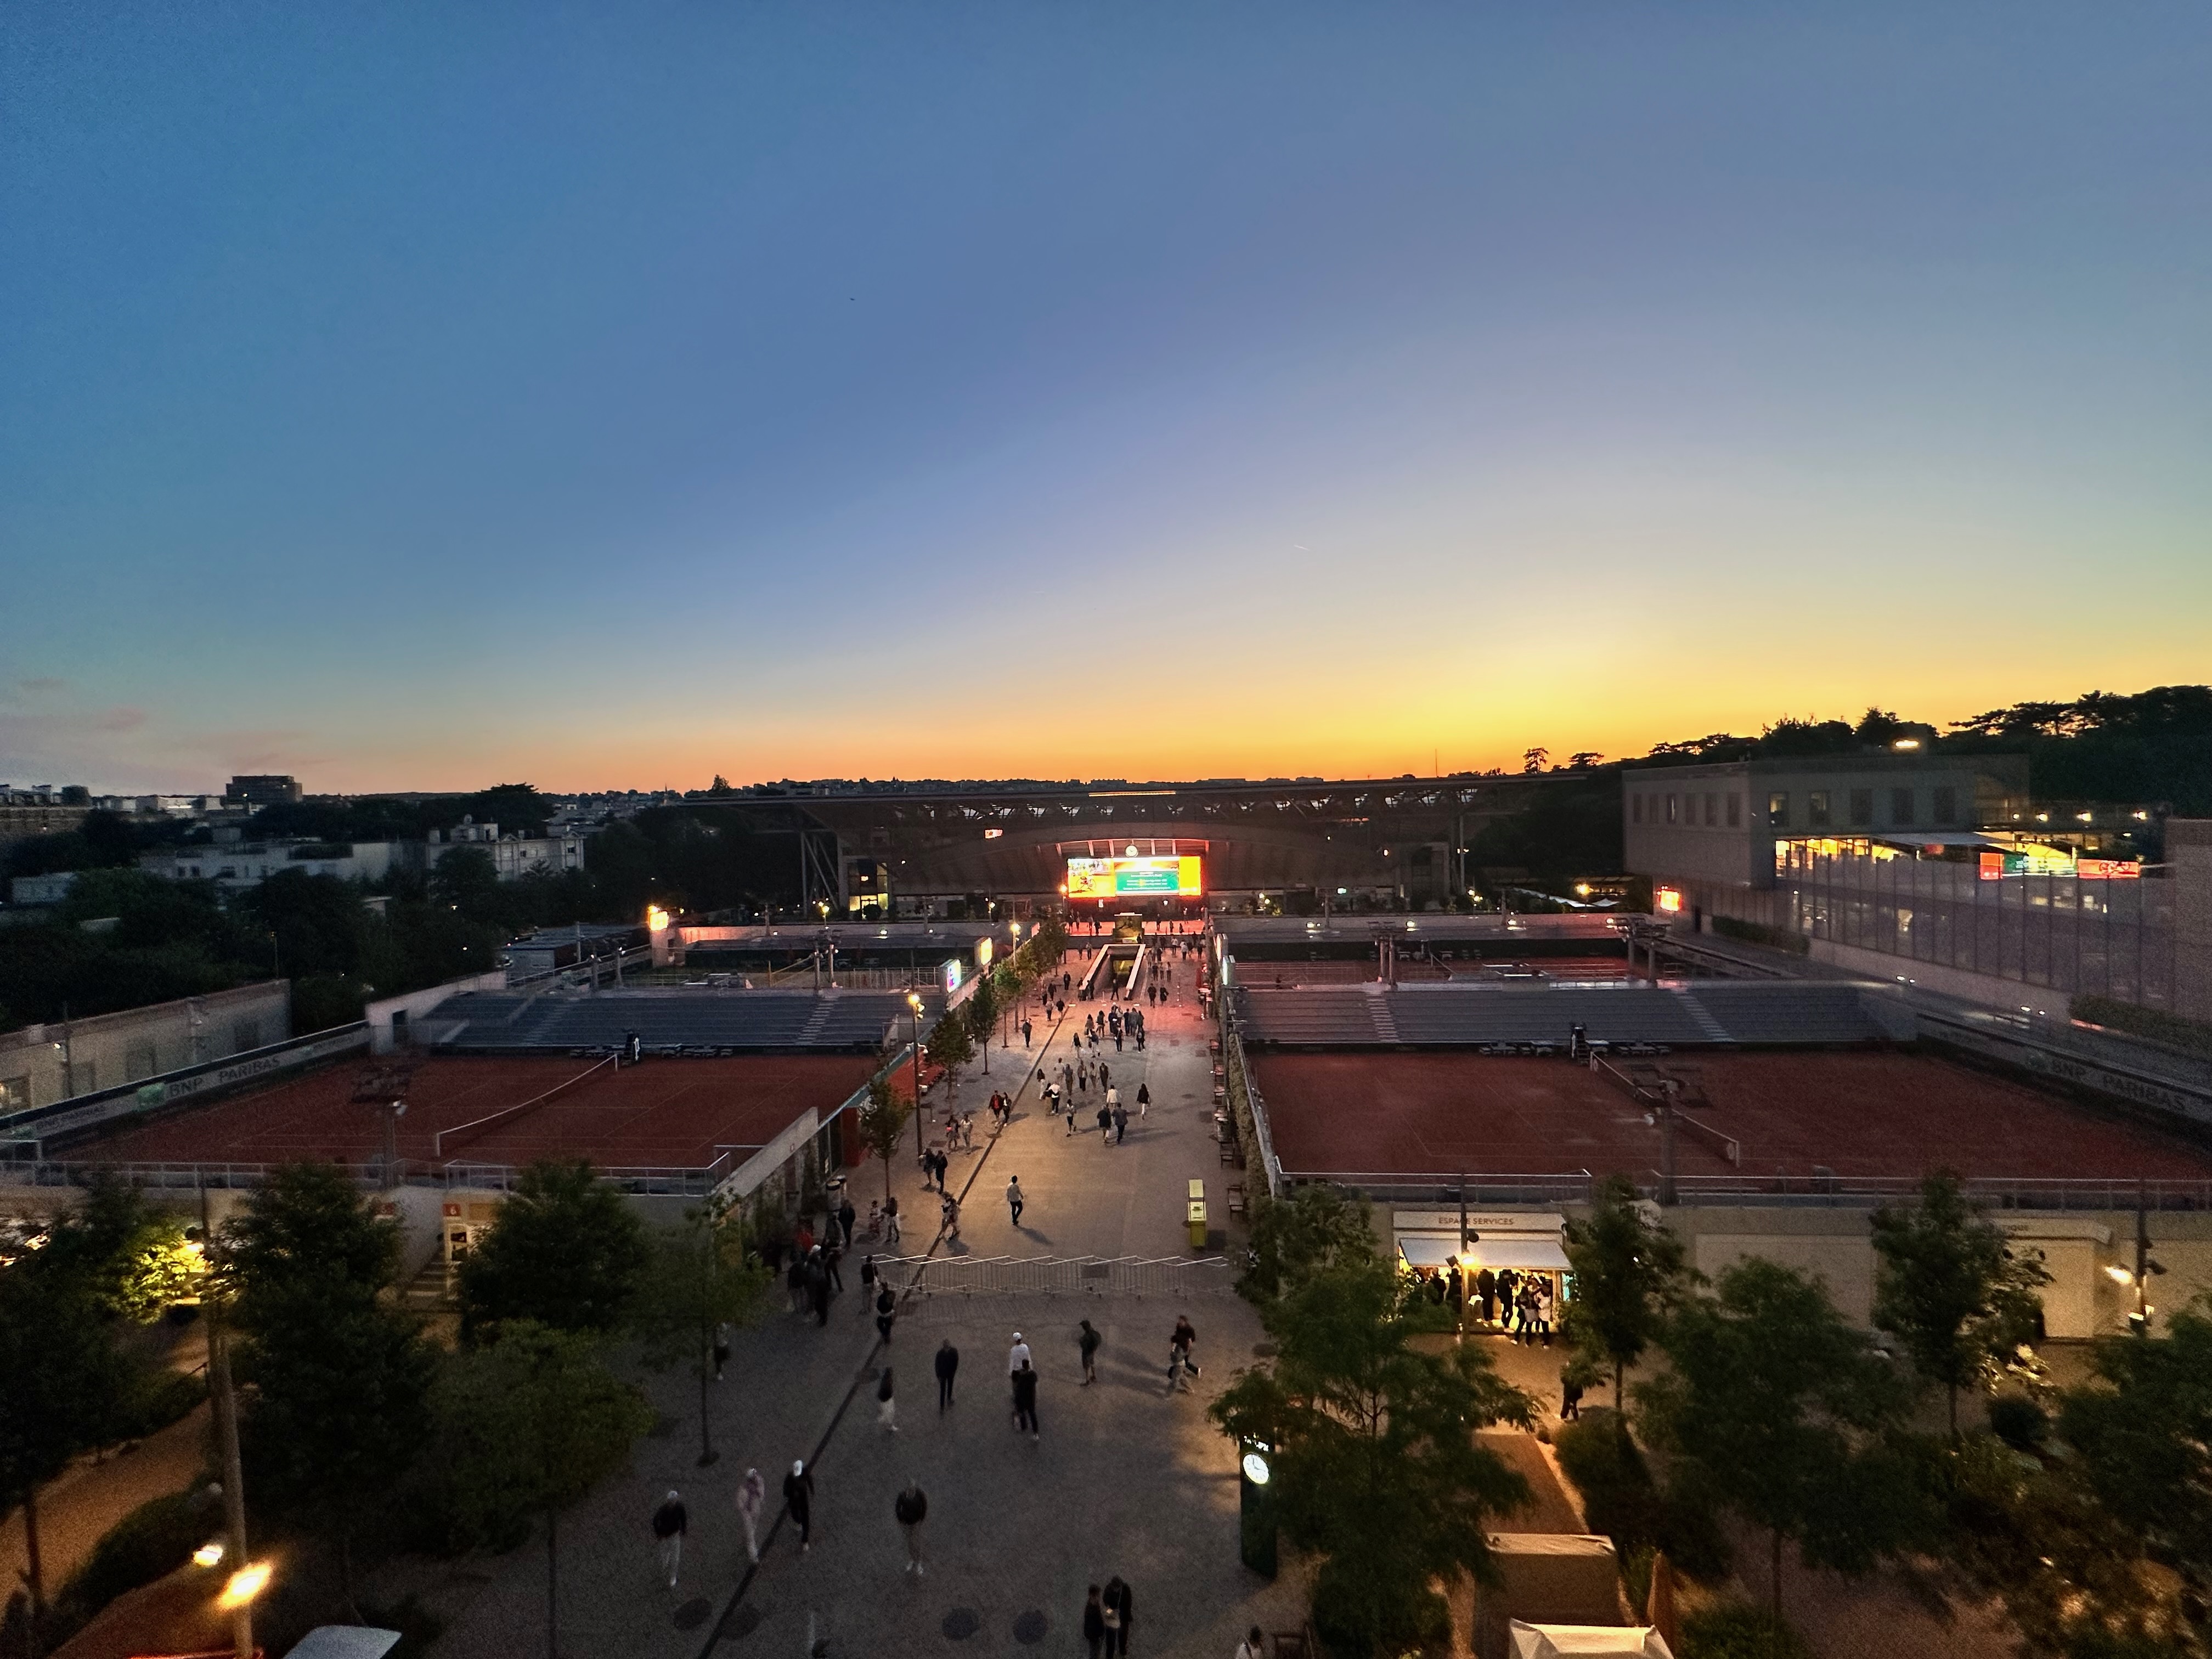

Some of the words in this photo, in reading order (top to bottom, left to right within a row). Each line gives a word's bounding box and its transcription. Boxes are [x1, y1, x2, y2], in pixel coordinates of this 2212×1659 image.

[170, 1077, 204, 1097] BNP
[218, 1057, 280, 1084] PARIBAS
[2103, 1074, 2186, 1111] PARIBAS
